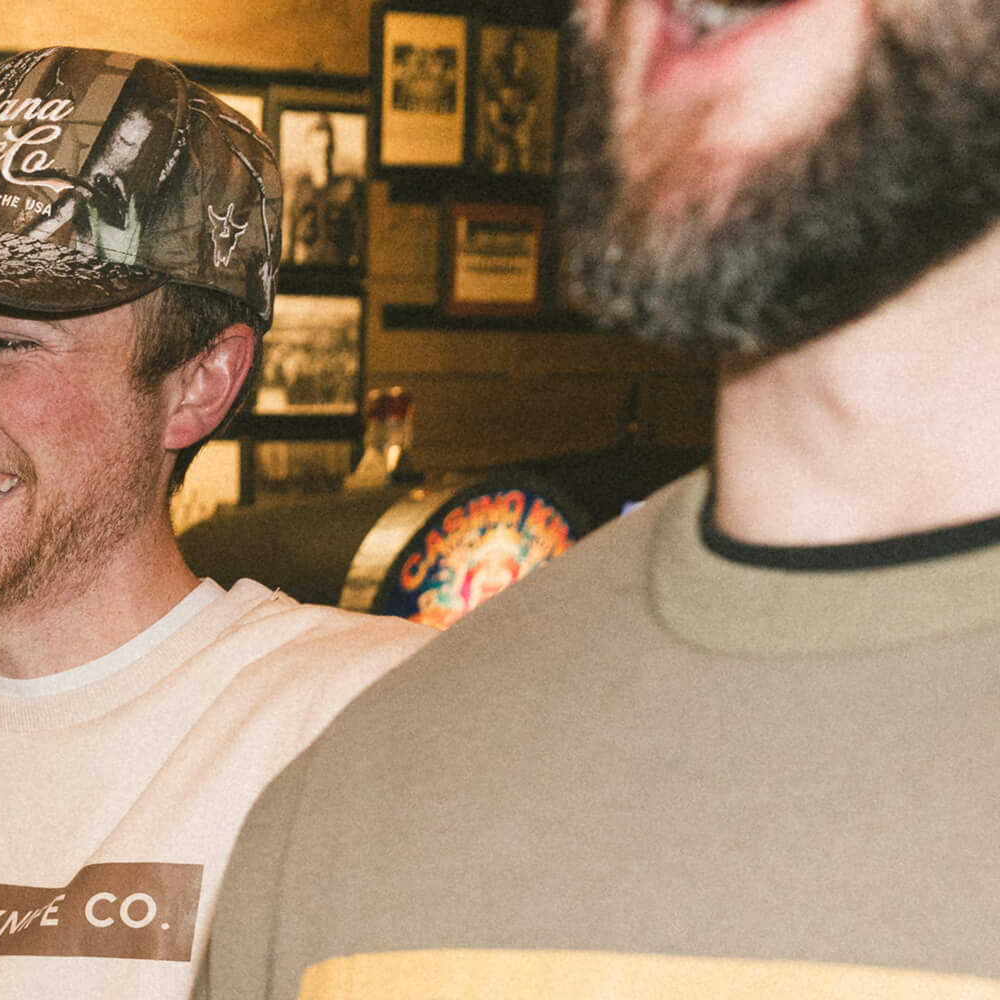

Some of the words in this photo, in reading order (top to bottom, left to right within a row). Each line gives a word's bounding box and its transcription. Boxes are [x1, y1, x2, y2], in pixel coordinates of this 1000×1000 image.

[1, 124, 75, 194] Co
[24, 198, 53, 217] USA
[84, 891, 170, 930] CO.
